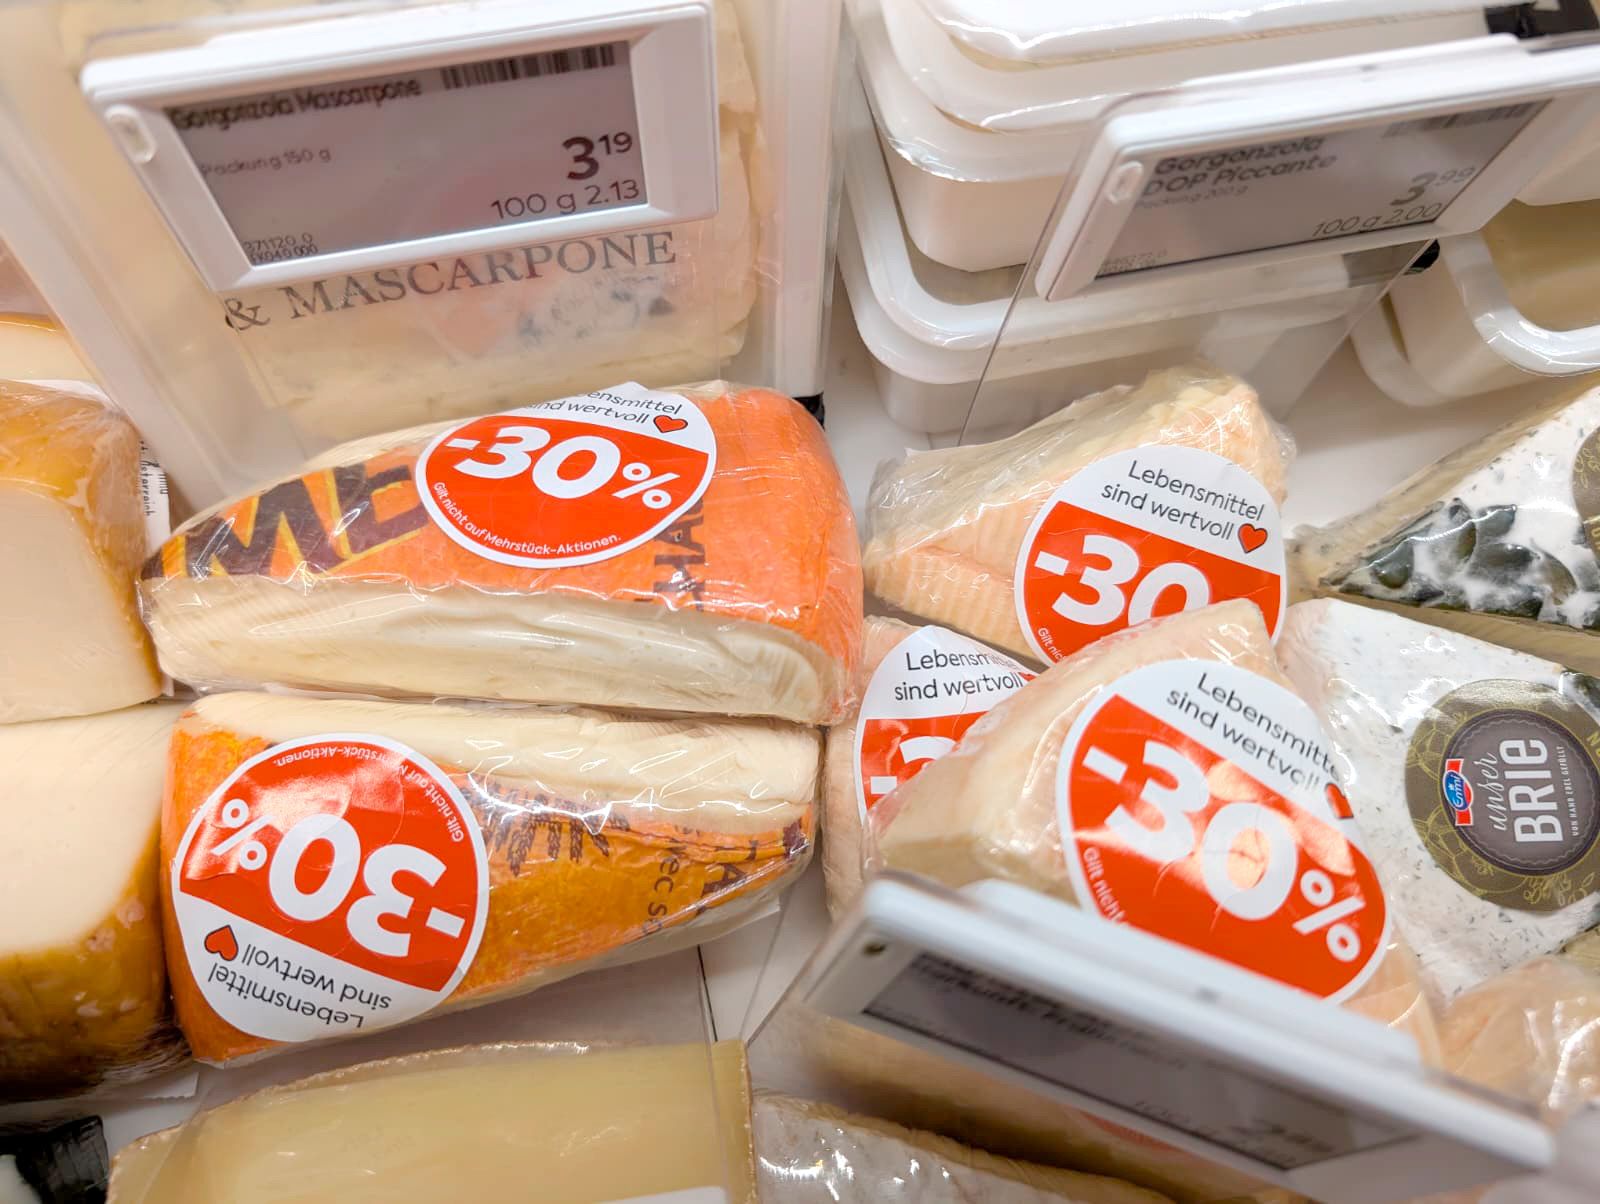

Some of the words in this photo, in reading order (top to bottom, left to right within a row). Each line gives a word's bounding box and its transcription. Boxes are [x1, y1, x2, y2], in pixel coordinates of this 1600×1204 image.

[298, 79, 421, 112] Mascarpone
[284, 149, 314, 164] 150
[319, 149, 331, 162] g
[1144, 172, 1208, 196] DOP
[1213, 155, 1337, 185] Piccante
[1155, 136, 1325, 175] Gorgonzola
[490, 193, 547, 219] 100
[556, 192, 577, 215] g
[584, 179, 640, 205] 2.13
[1311, 215, 1360, 237] 100
[1384, 202, 1443, 225] 2.00
[225, 296, 271, 331] &
[281, 231, 676, 319] MASCARPONE
[567, 402, 650, 424] wertvoll
[587, 391, 683, 415] ensmittel
[445, 425, 681, 510] -30%
[1128, 460, 1265, 522] Lebensmittel
[433, 481, 450, 502] Gilt
[443, 498, 468, 527] nicht
[464, 519, 487, 538] auf
[483, 530, 622, 555] Mehrstück-Aktionen.
[1101, 483, 1148, 511] sind
[1151, 501, 1235, 541] wertvoll
[1034, 534, 1210, 627] -30
[894, 678, 938, 701] sind
[944, 672, 1024, 699] wertvoll
[1166, 689, 1219, 730] sind
[1221, 722, 1321, 791] wertvoll
[1197, 672, 1341, 782] Lebensmitte
[405, 770, 428, 789] auf
[1450, 773, 1466, 808] Emmi
[1474, 752, 1508, 831] unser
[423, 784, 453, 818] nicht
[446, 816, 464, 842] Gilt
[1082, 739, 1366, 962] -30%
[1083, 847, 1104, 886] Gilt
[210, 798, 465, 957] -30%
[242, 943, 335, 994] wertvoll
[207, 962, 364, 1029] Lebensmittel
[340, 985, 392, 1010] sind
